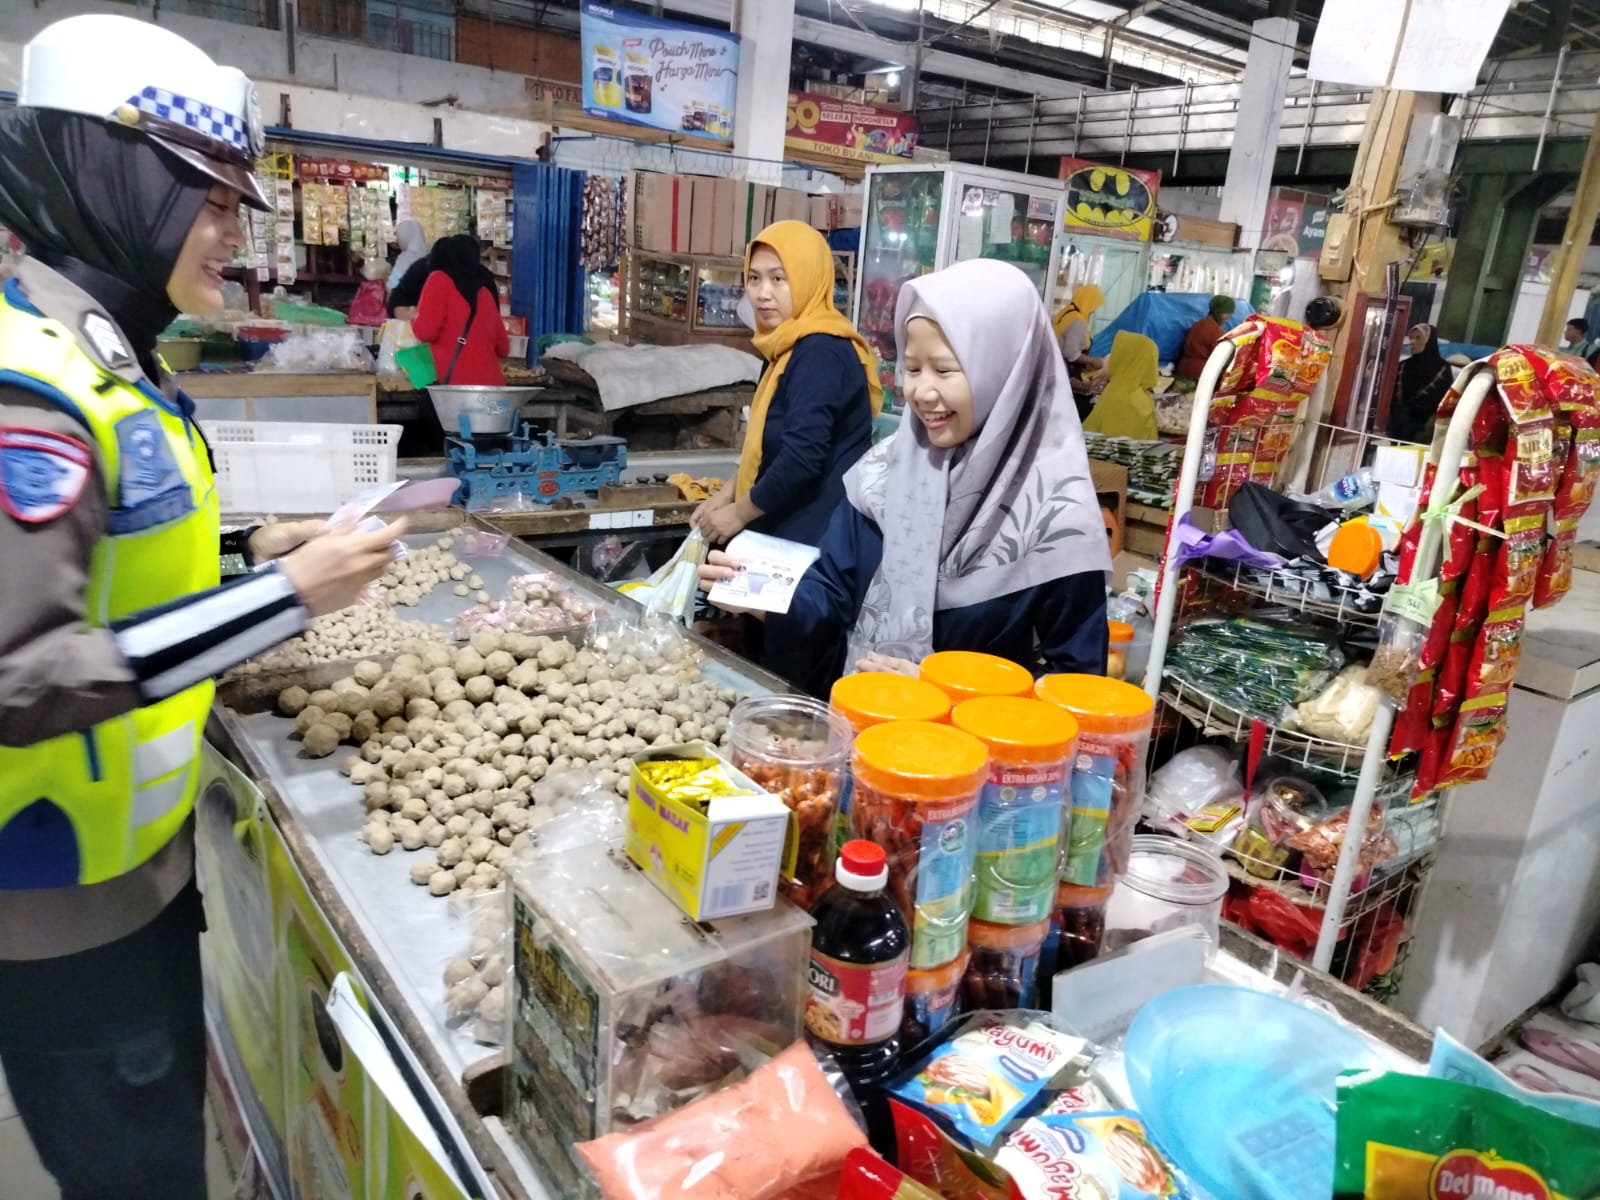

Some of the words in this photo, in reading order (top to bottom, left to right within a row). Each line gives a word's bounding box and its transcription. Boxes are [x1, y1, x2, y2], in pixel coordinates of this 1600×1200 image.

[649, 38, 689, 58] Pouch
[689, 41, 717, 60] Mini
[656, 61, 694, 82] Harga
[695, 63, 721, 81] Mini
[821, 111, 850, 121] SELERA
[852, 114, 895, 126] INDONESIA
[813, 143, 839, 156] TOKO
[842, 149, 856, 158] BU
[857, 152, 874, 161] ANI
[1002, 773, 1026, 785] EXTRA
[1026, 772, 1048, 784] BESAR
[1439, 1170, 1470, 1195] Del
